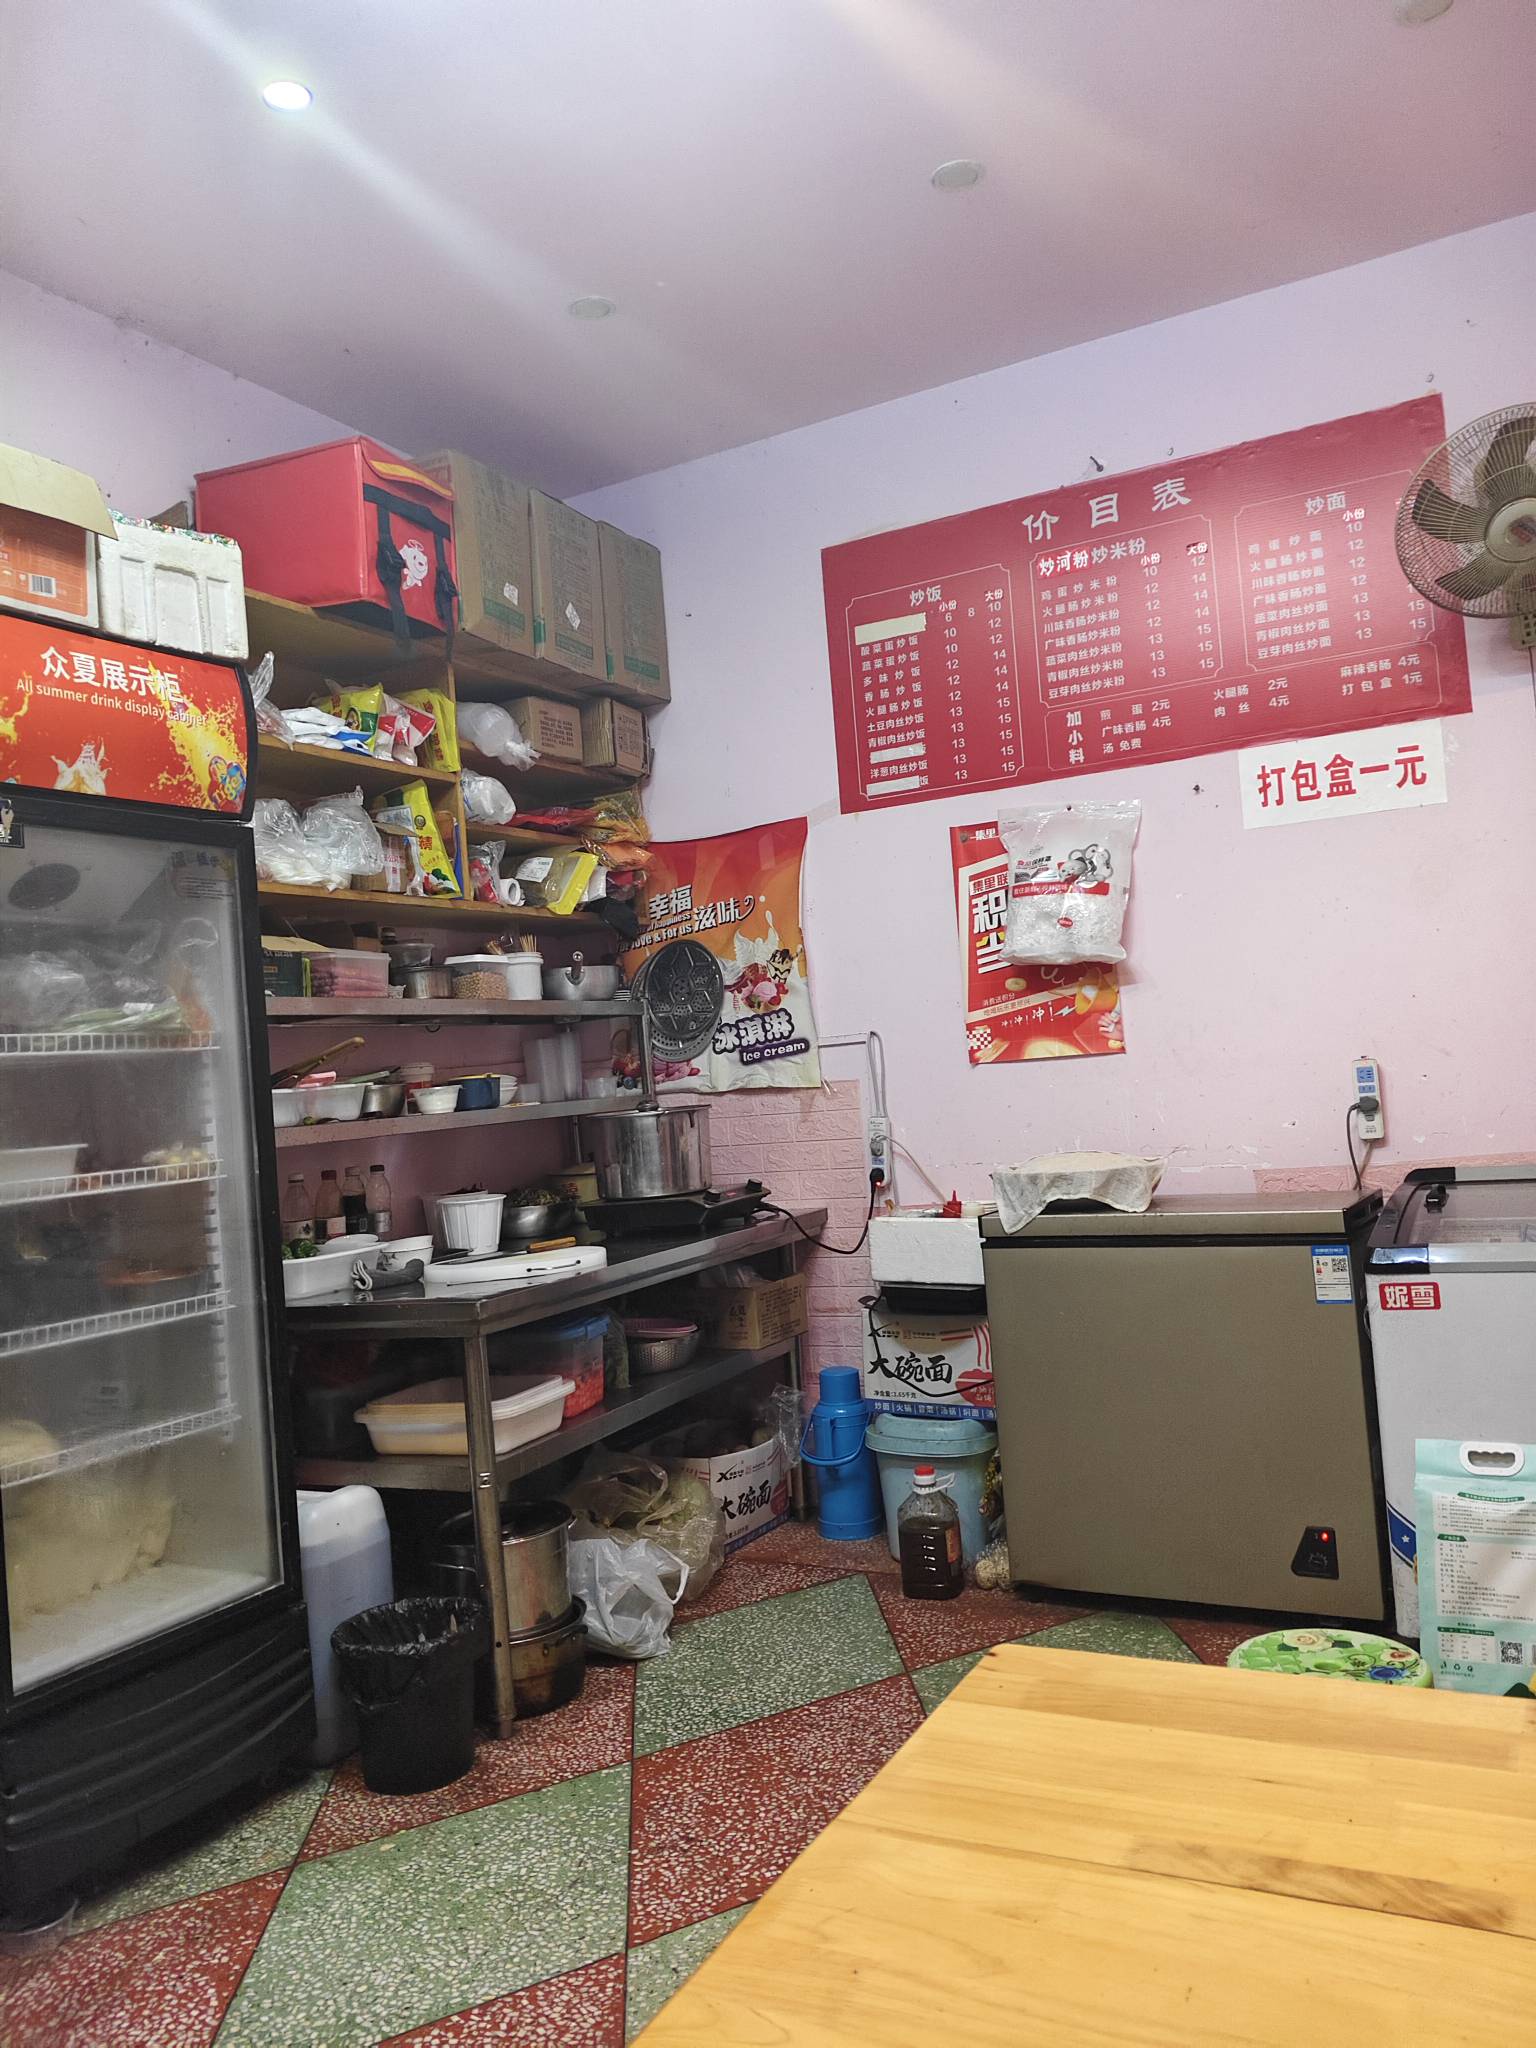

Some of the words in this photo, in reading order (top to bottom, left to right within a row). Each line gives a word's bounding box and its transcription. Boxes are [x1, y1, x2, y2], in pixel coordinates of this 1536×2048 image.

[1022, 477, 1192, 544] 价目表
[1305, 490, 1346, 515] 炒面
[1346, 521, 1362, 533] 10
[1348, 539, 1365, 550] 12
[1039, 550, 1089, 577] 炒河粉
[1092, 537, 1146, 564] 炒米粉
[1140, 553, 1161, 566] 小份
[1143, 565, 1158, 577] 10
[1191, 555, 1205, 566] 12
[1349, 557, 1366, 568] 12
[1144, 583, 1159, 594] 12
[1193, 573, 1207, 584] 14
[1351, 575, 1367, 586] 12
[910, 585, 941, 607] 炒饭
[939, 599, 957, 612] 小份
[985, 588, 1004, 602] 大份
[1352, 592, 1369, 604] 13
[945, 612, 952, 622] 6
[968, 607, 976, 617] 8
[988, 601, 1001, 612] 10
[1044, 608, 1119, 634] 川味香肠炒米粉
[1145, 599, 1160, 611] 12
[1193, 590, 1208, 601] 14
[1353, 610, 1371, 622] 13
[1407, 599, 1425, 611] 15
[944, 627, 957, 638] 10
[988, 617, 1002, 629] 12
[1045, 625, 1121, 650] 广味香肠炒米粉
[1147, 616, 1161, 627] 12
[1195, 607, 1209, 618] 14
[1148, 633, 1163, 645] 13
[1197, 623, 1212, 635] 15
[1355, 628, 1373, 640] 13
[1409, 618, 1426, 630] 15
[945, 643, 958, 654] 10
[989, 634, 1003, 645] 12
[864, 666, 921, 687] 多味炒饭
[946, 659, 959, 669] 12
[993, 649, 1006, 660] 14
[1047, 658, 1124, 683] 青椒肉丝炒米粉
[1151, 650, 1165, 661] 13
[1198, 640, 1213, 652] 15
[1340, 658, 1392, 677] 麻辣香肠
[1398, 654, 1420, 667] 4元
[40, 645, 187, 703] 众夏展示柜
[864, 682, 922, 702] 香肠炒饭
[947, 675, 960, 685] 12
[994, 665, 1008, 676] 14
[1048, 675, 1125, 699] 豆芽肉丝炒米粉
[1151, 667, 1166, 678] 13
[1200, 657, 1214, 669] 15
[1342, 677, 1392, 696] 打包盒
[1402, 671, 1423, 685] 1元
[866, 697, 923, 717] 火腿肠炒饭
[948, 690, 961, 701] 12
[996, 681, 1009, 692] 14
[1214, 684, 1249, 700] 火腿肠
[1268, 677, 1288, 690] 2元
[16, 678, 33, 695] All
[36, 683, 89, 704] summer
[90, 692, 122, 710] drink
[124, 699, 165, 721] display
[167, 709, 208, 727] cabinet
[1152, 699, 1170, 712] 2元
[1214, 702, 1250, 718] 肉丝
[1269, 695, 1290, 707] 4元
[867, 713, 925, 732] 土豆肉丝炒饭
[950, 706, 963, 717] 13
[997, 697, 1011, 708] 15
[1102, 719, 1147, 737] 广味香肠
[1152, 715, 1171, 728] 4元
[868, 728, 926, 748] 青椒肉丝炒饭
[951, 722, 964, 733] 13
[998, 713, 1012, 724] 15
[952, 738, 965, 749] 13
[999, 729, 1013, 740] 15
[1066, 711, 1085, 764] 加小料
[1119, 738, 1142, 751] 免费
[870, 760, 928, 779] 洋葱肉丝炒饭
[953, 753, 967, 765] 13
[1000, 745, 1014, 756] 15
[954, 769, 968, 780] 13
[1001, 761, 1015, 772] 15
[1257, 744, 1428, 808] 打包盒一元
[649, 884, 693, 920] 幸福
[694, 895, 755, 933] 滋味
[715, 1012, 793, 1051] 冰淇淋
[743, 1049, 761, 1063] Ice
[764, 1041, 806, 1059] cream
[1384, 1285, 1435, 1308] 妮雪
[867, 1351, 953, 1384] 大碗面
[720, 1479, 772, 1519] 大碗面
